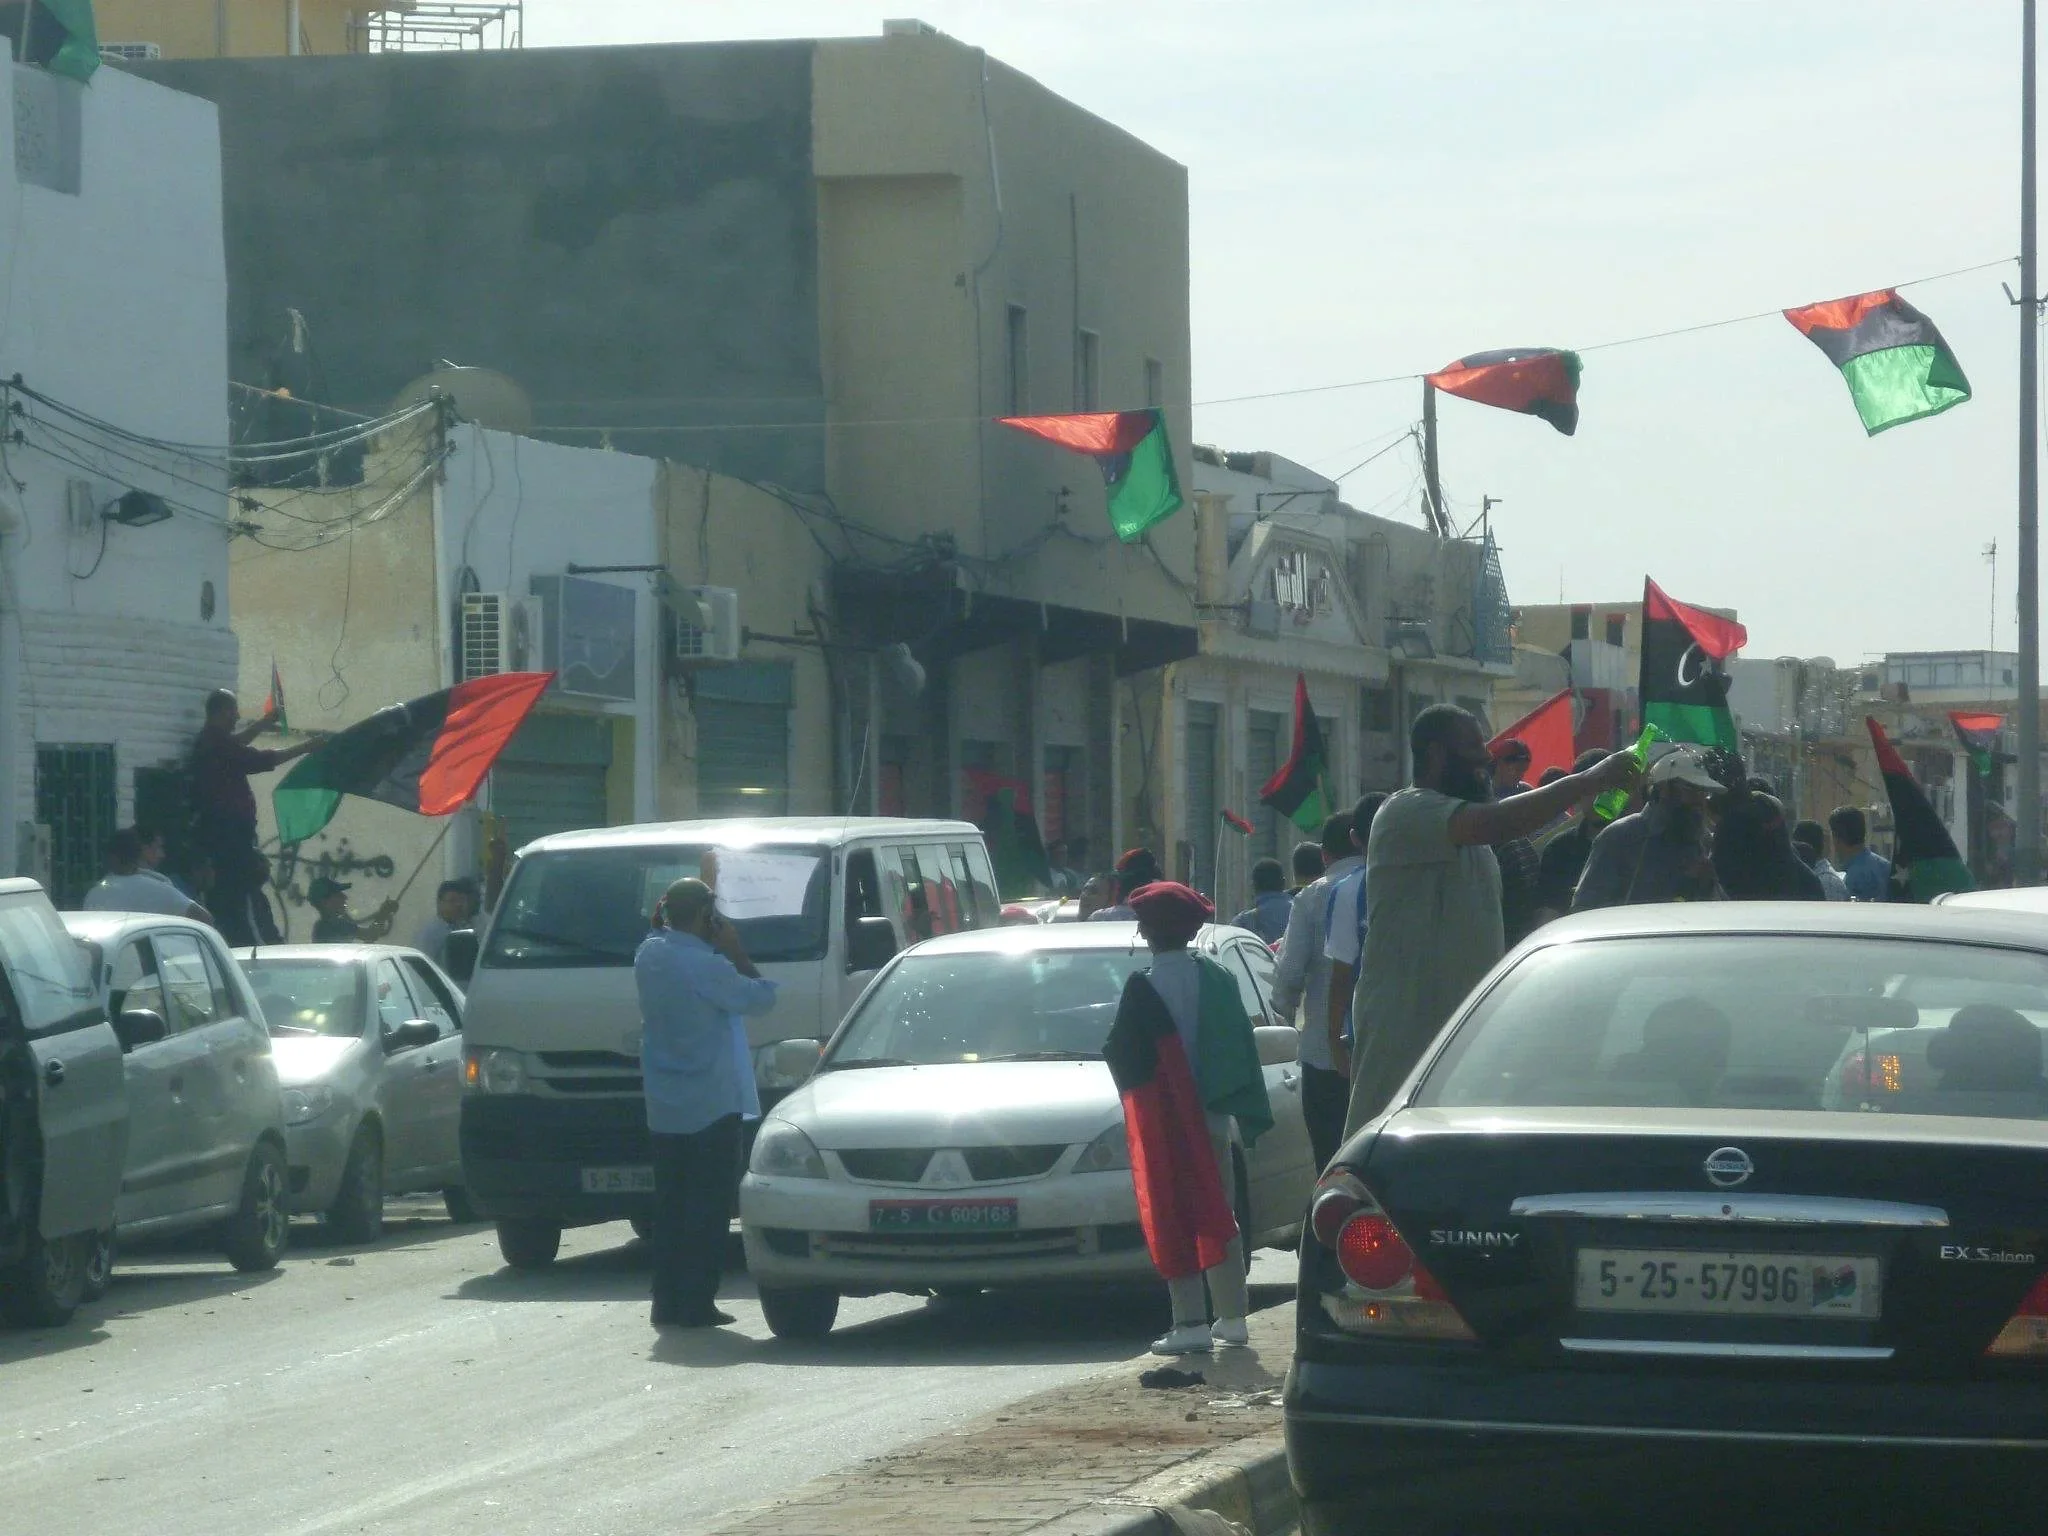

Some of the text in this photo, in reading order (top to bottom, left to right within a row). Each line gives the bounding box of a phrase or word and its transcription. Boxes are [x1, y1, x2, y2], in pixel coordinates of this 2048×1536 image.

[1430, 1230, 1520, 1246] SUNNY
[1941, 1245, 2035, 1263] EX Saloon
[1600, 1260, 1799, 1302] 5-25-57996
